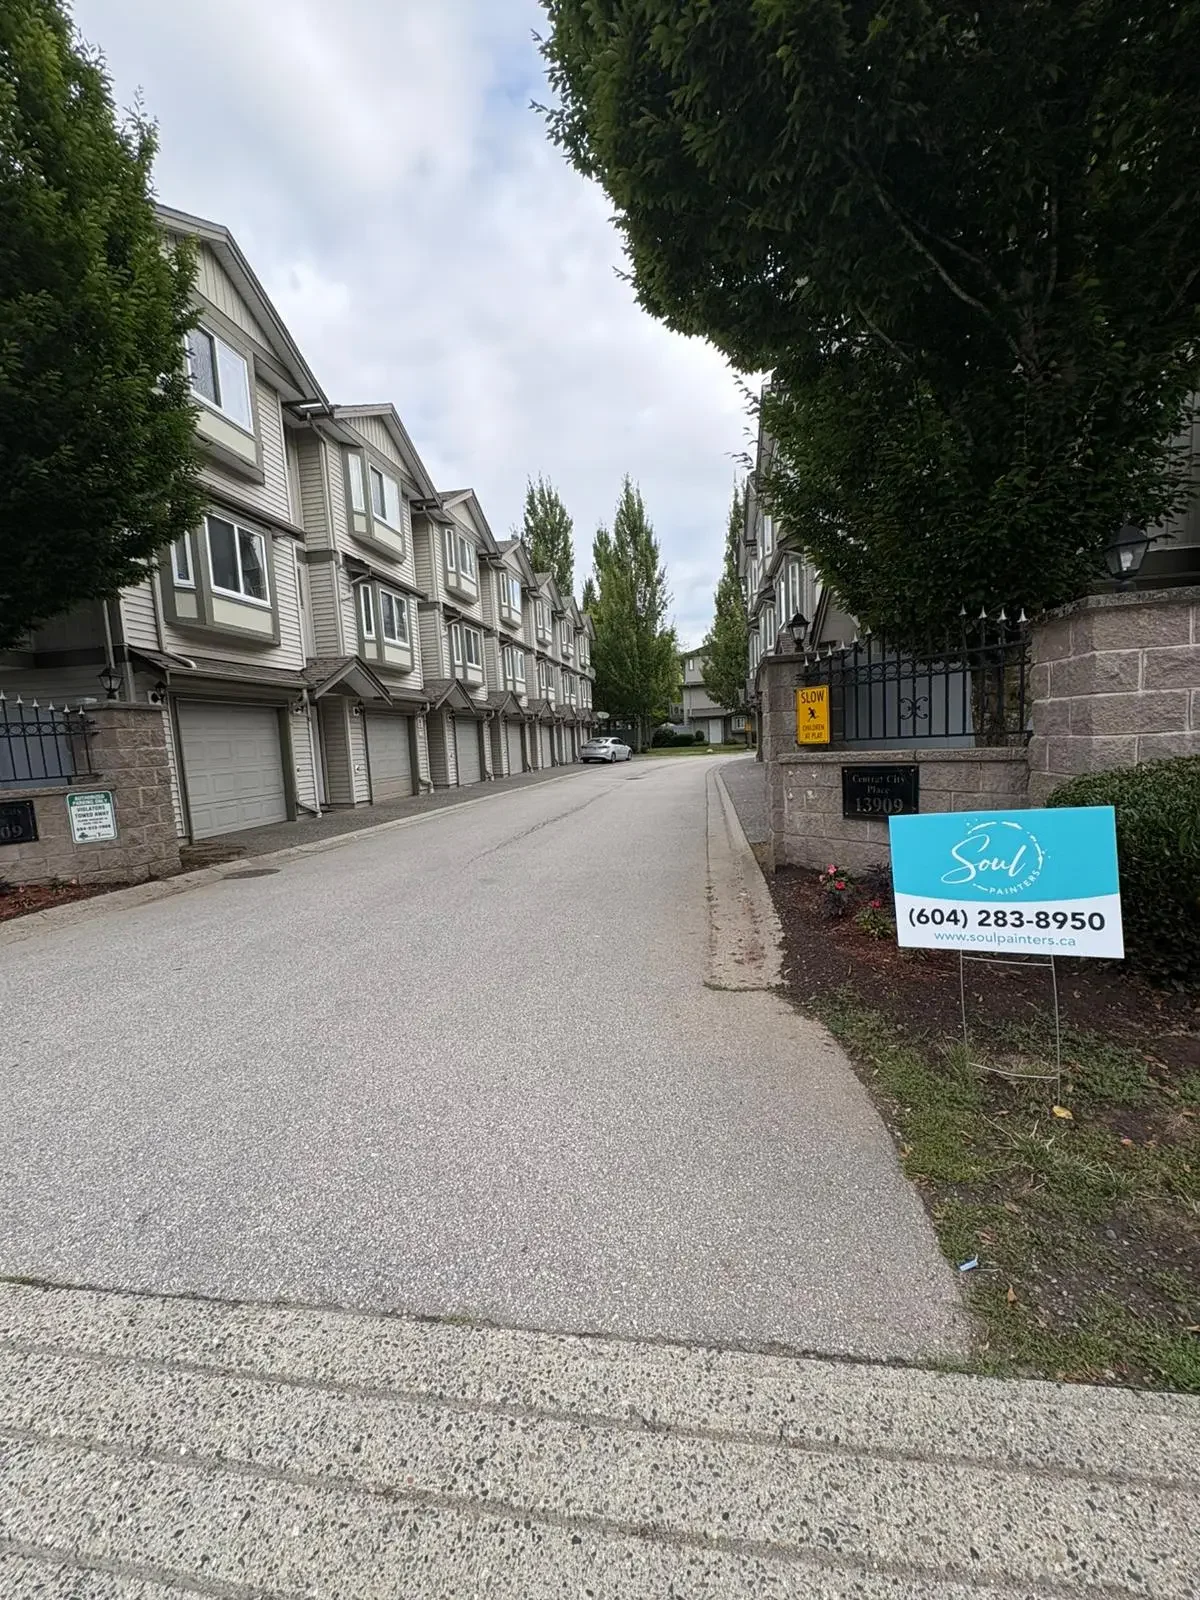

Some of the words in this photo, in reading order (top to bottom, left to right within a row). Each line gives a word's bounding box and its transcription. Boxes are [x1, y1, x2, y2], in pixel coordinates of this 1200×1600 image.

[801, 689, 824, 704] SLOW
[802, 723, 824, 732] CHILDREN
[812, 731, 823, 739] PLAY
[852, 774, 883, 784] Central
[886, 774, 905, 785] City
[867, 785, 890, 794] Place
[856, 797, 904, 814] 13909
[940, 834, 1028, 885] Soul
[988, 869, 1041, 896] PAINTERS
[908, 907, 969, 929] (604)
[977, 909, 1106, 931] 283-8950
[934, 930, 1076, 947] www.soulpainters.ca
